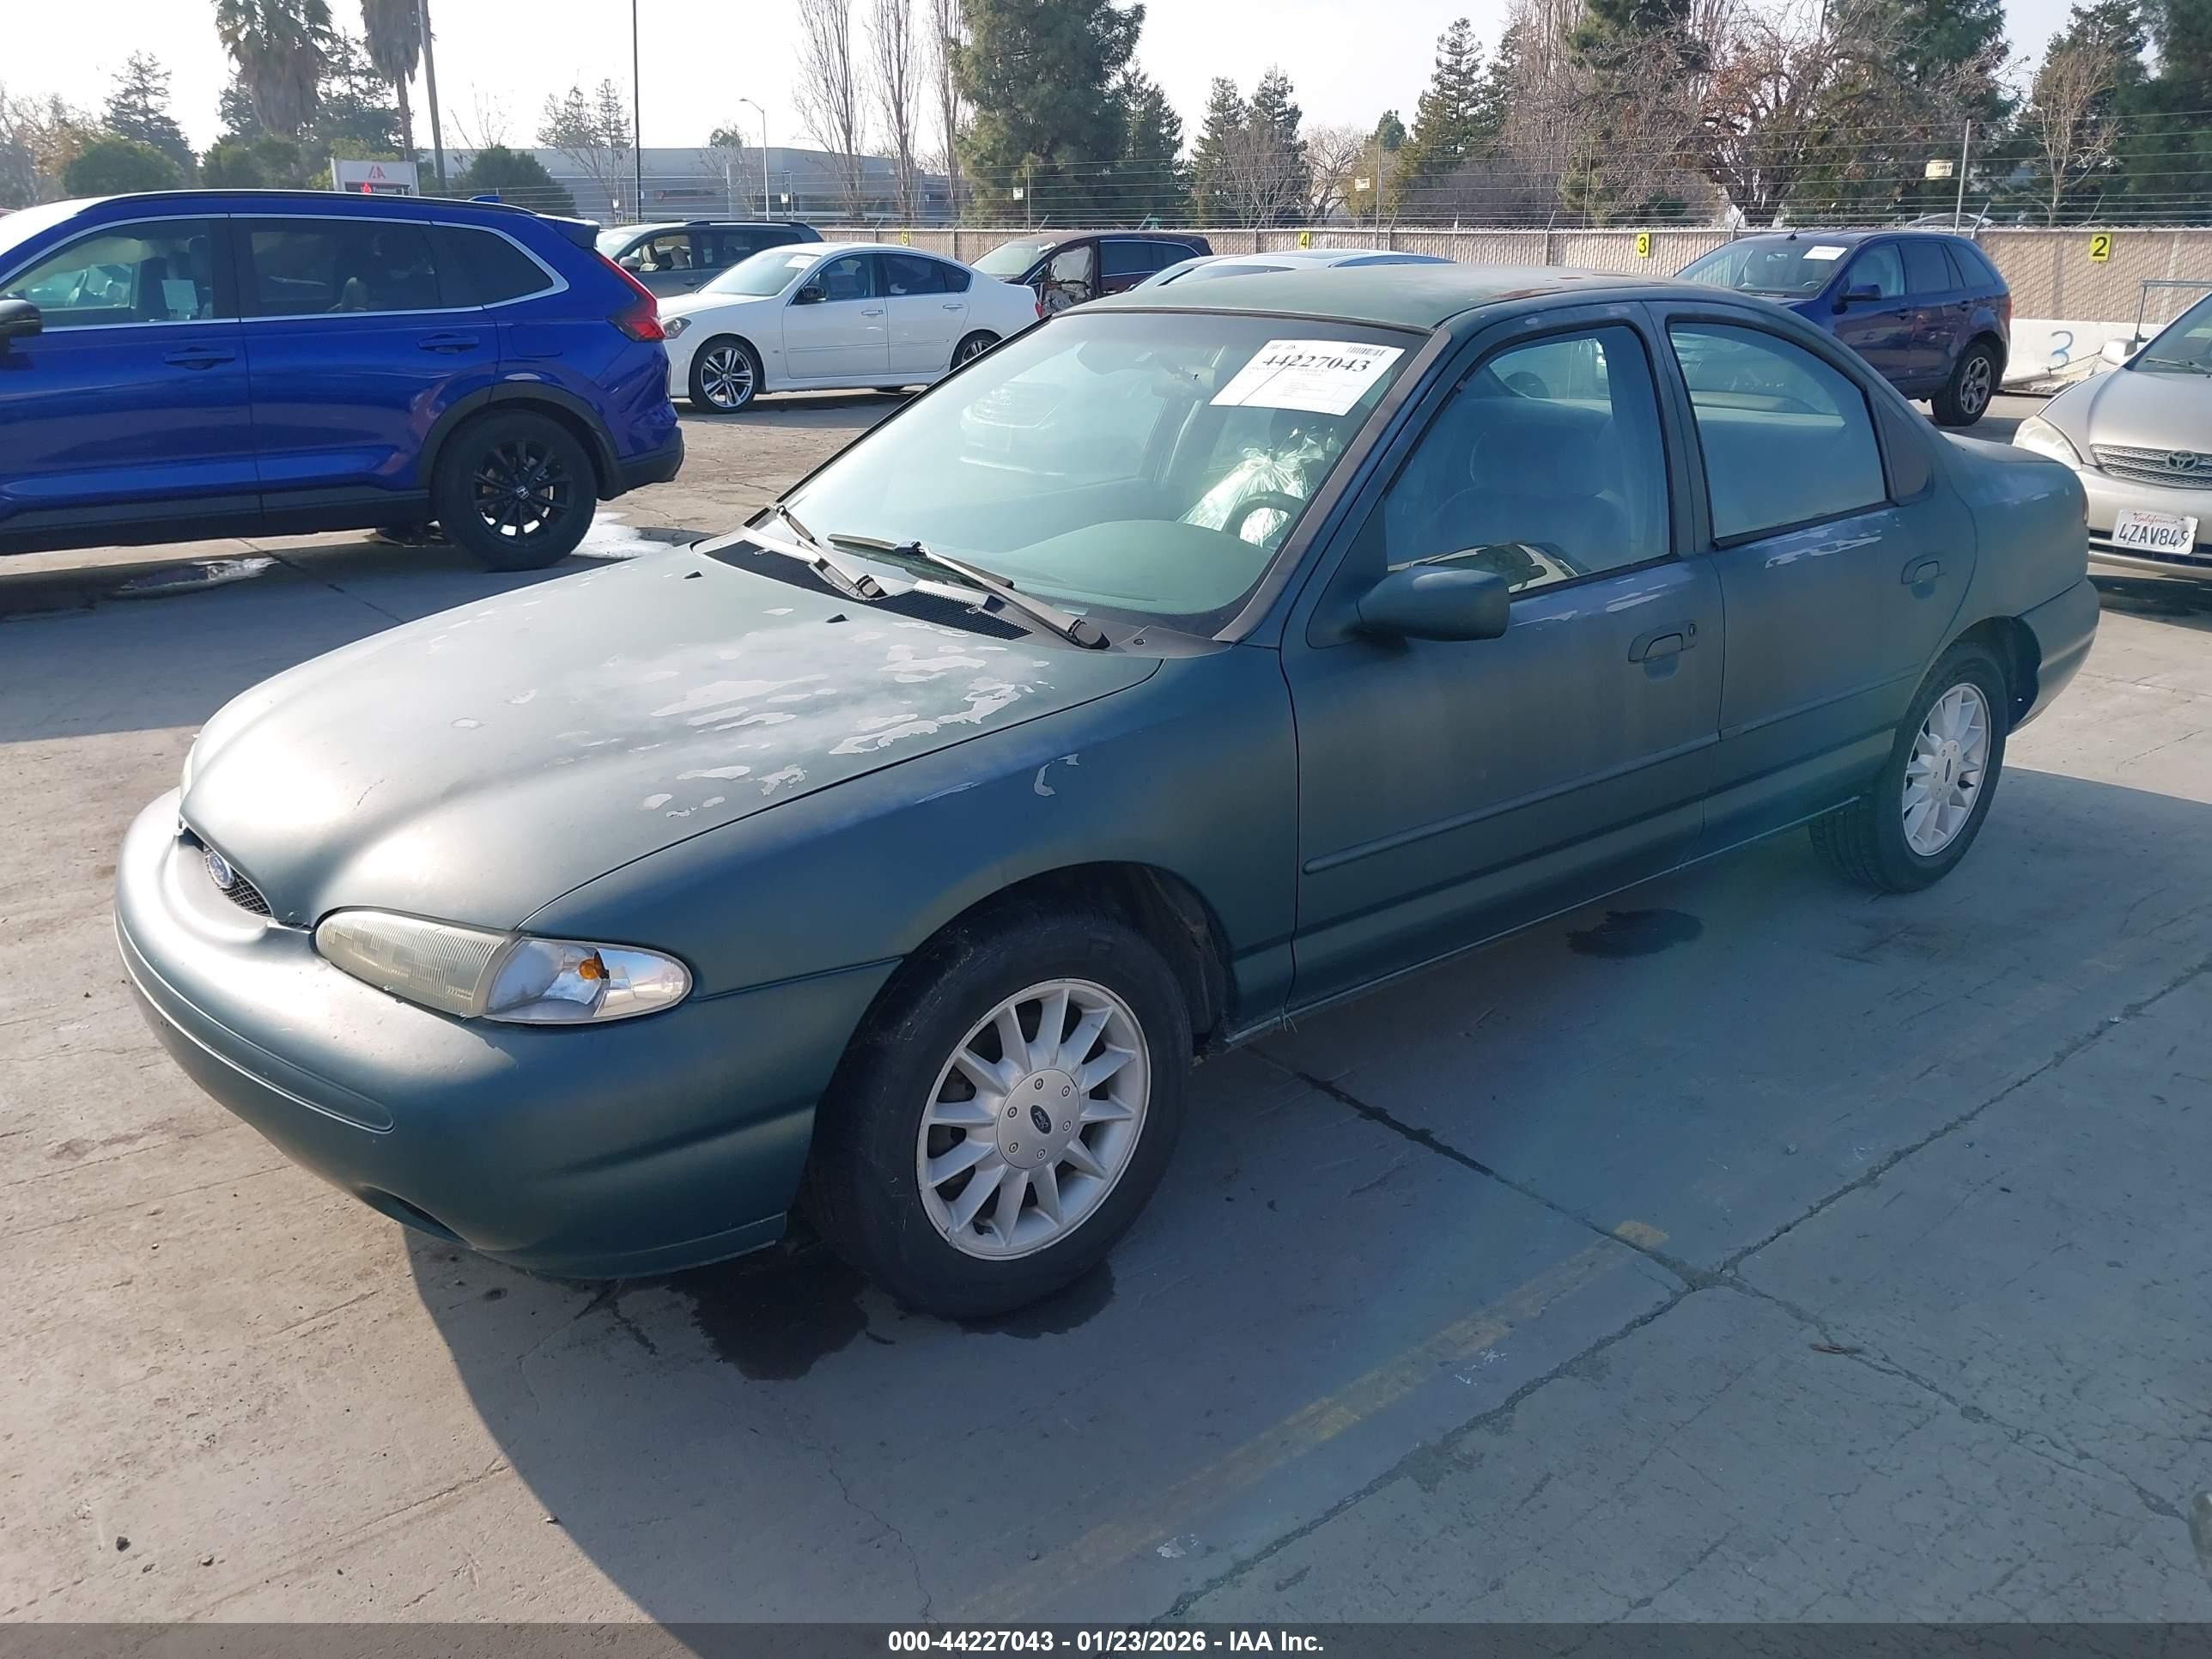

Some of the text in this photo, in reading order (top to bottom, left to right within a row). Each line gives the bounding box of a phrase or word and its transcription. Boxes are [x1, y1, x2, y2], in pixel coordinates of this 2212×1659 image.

[902, 233, 908, 244] 6
[1301, 234, 1308, 248] 4
[1638, 236, 1647, 253] 3
[2092, 236, 2108, 257] 2
[1262, 354, 1371, 373] 44227043
[2118, 522, 2190, 549] 4ZAV849
